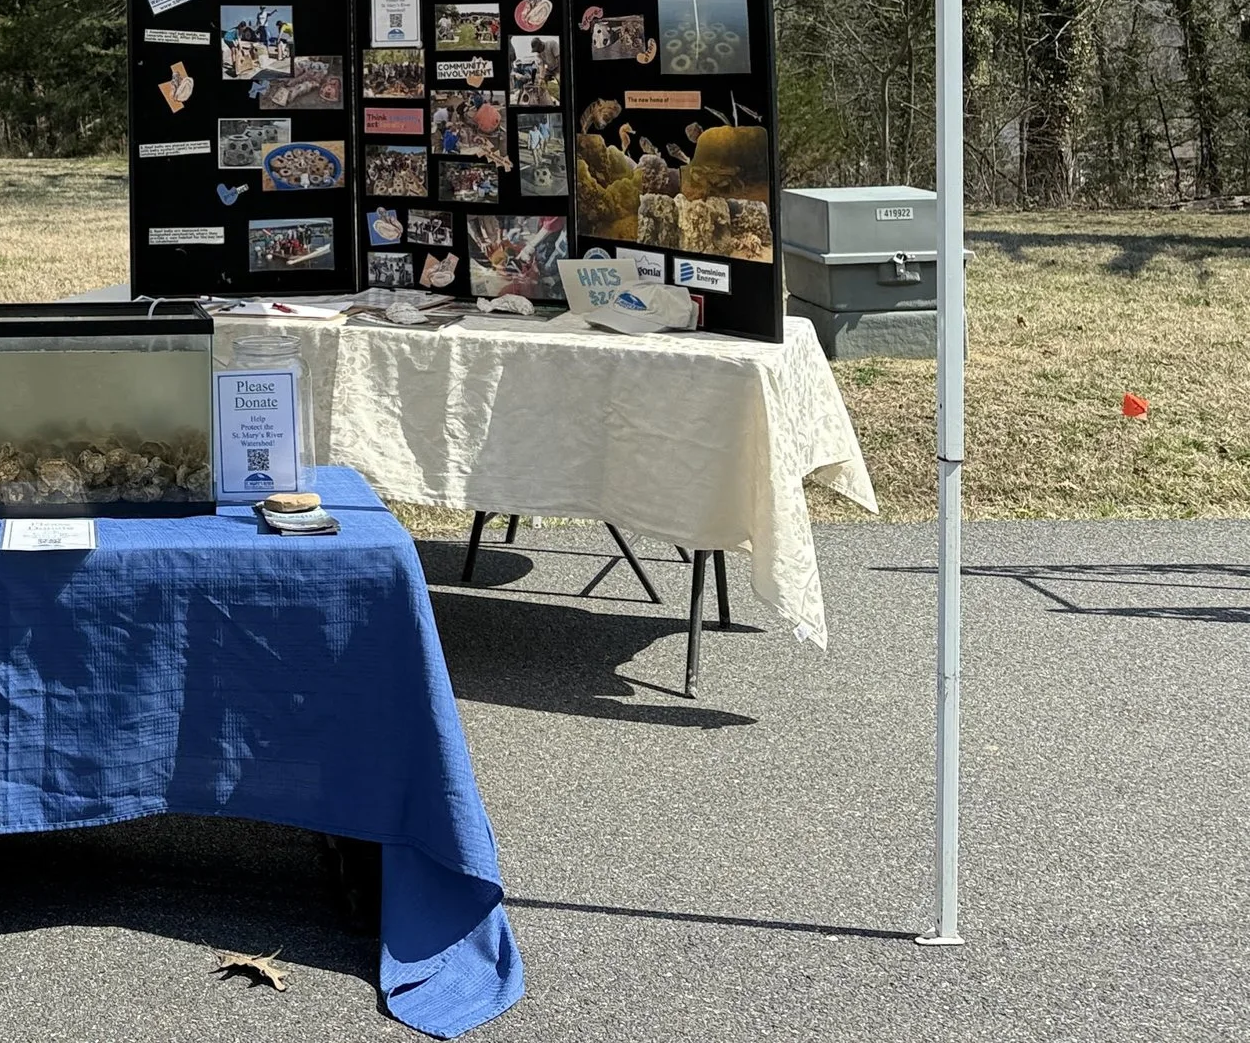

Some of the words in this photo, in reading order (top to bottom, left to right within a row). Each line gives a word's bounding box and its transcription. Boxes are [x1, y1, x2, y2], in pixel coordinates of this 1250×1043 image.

[437, 62, 488, 71] COMMUNITY
[366, 113, 387, 121] Think
[884, 208, 911, 217] 419922
[576, 267, 622, 287] HATS
[696, 266, 726, 278] Dominion
[696, 275, 720, 285] Energy
[236, 380, 275, 393] Please
[235, 397, 278, 409] Donate
[242, 432, 264, 440] Mary's
